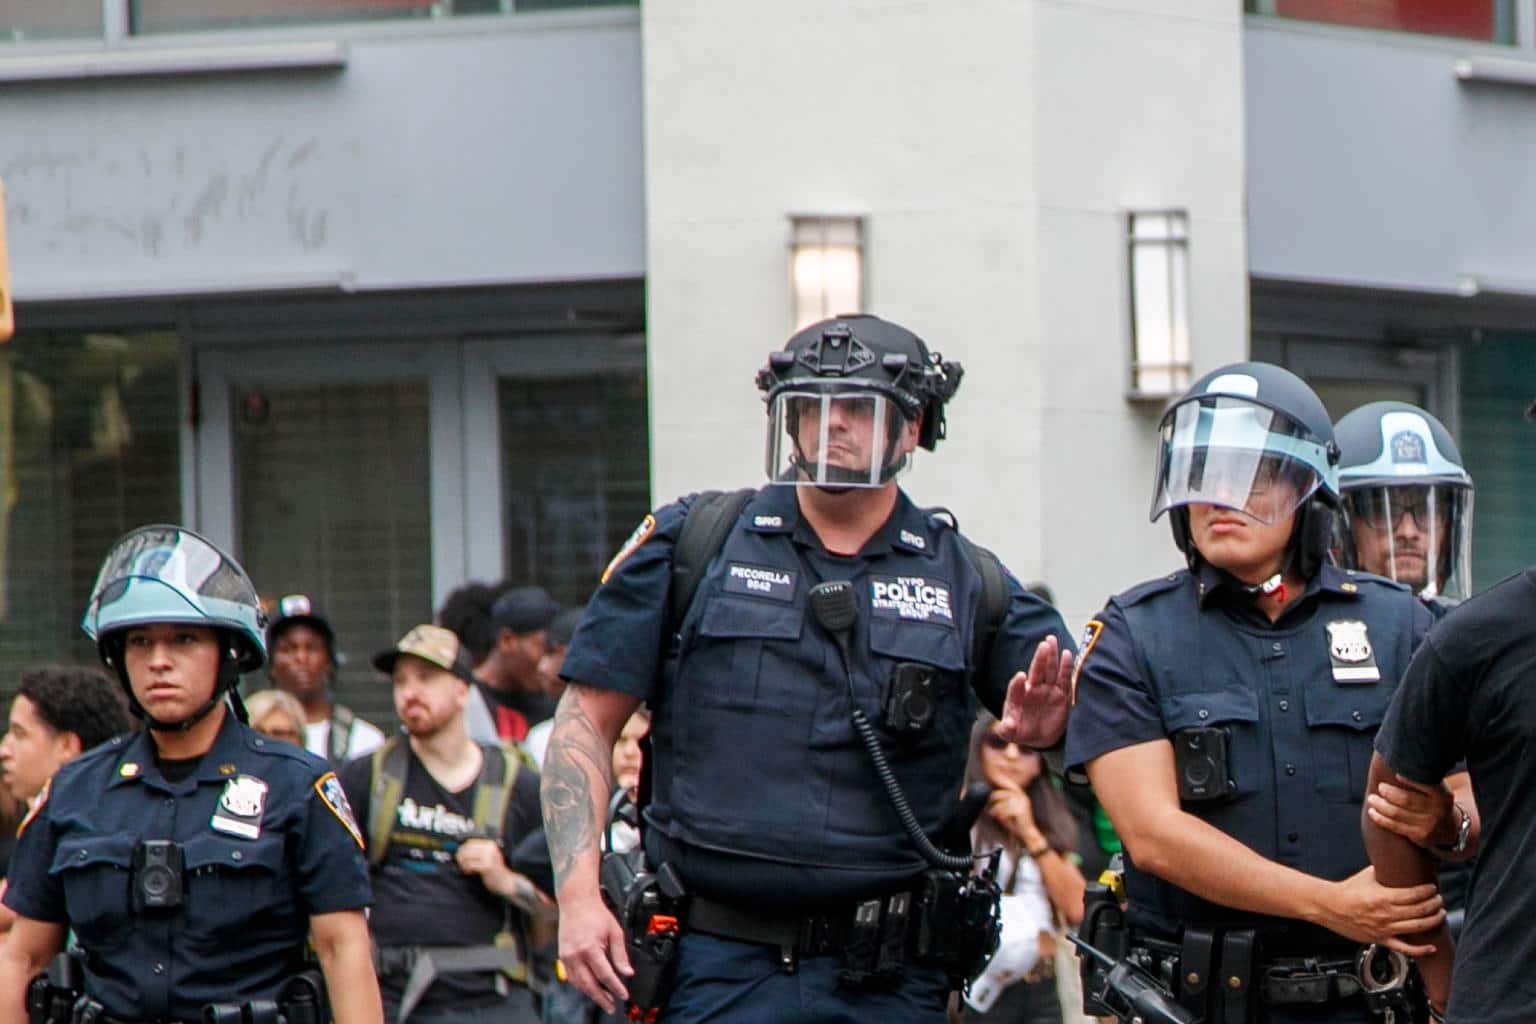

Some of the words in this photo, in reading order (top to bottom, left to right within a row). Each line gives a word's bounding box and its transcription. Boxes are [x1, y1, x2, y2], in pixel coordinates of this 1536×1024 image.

[754, 516, 782, 527] SRG
[900, 529, 925, 549] SRG
[873, 581, 949, 609] POLICE
